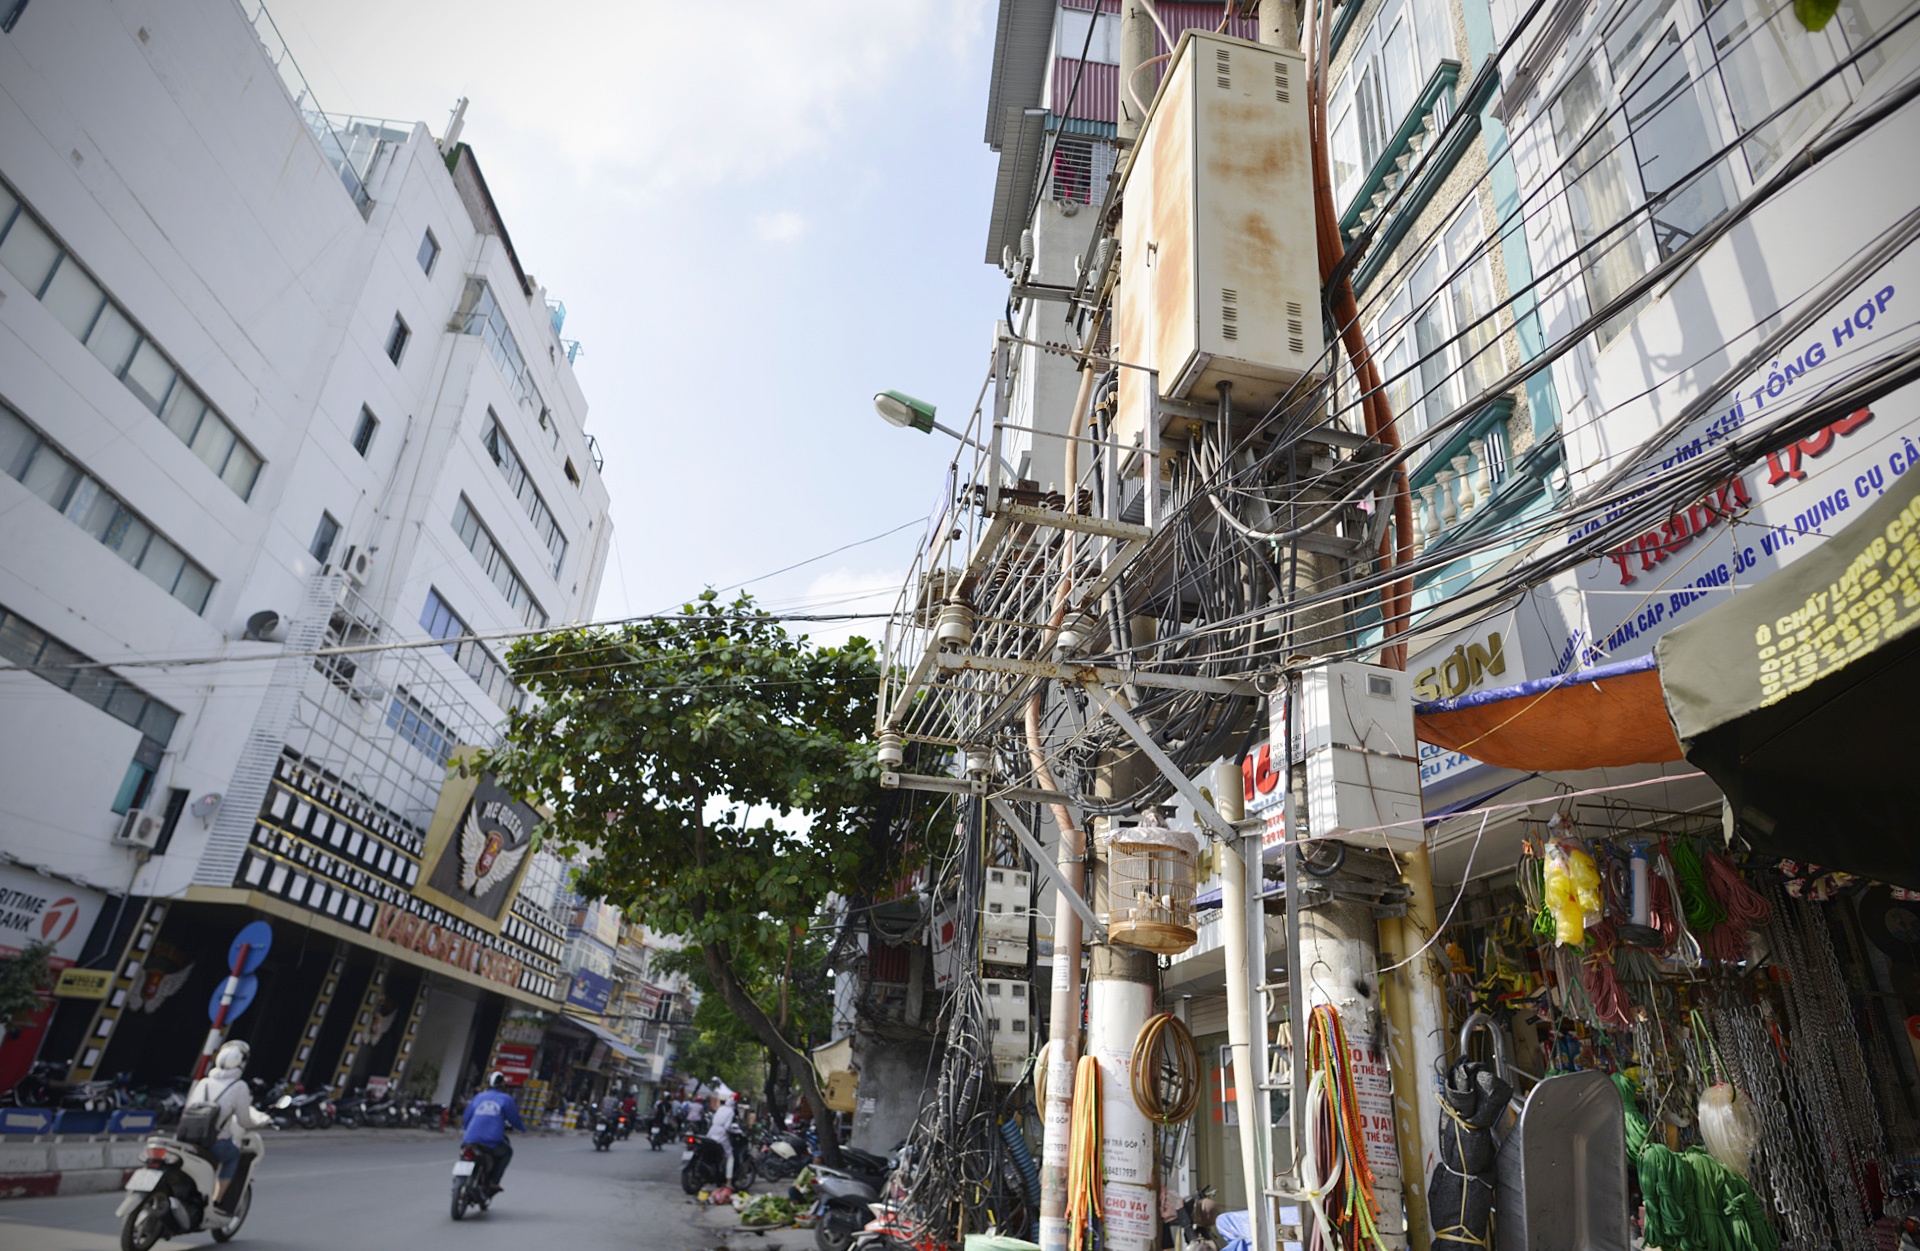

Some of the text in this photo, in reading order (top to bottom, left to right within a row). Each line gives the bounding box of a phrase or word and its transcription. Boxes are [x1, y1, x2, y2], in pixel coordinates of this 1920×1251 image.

[1751, 342, 1827, 408] TỔNG
[1832, 285, 1895, 347] HỢP
[1794, 488, 1851, 534] DỤNG
[1854, 468, 1884, 496] CỤ
[1892, 438, 1920, 483] CẦ
[1105, 1196, 1148, 1213] CHO VAY
